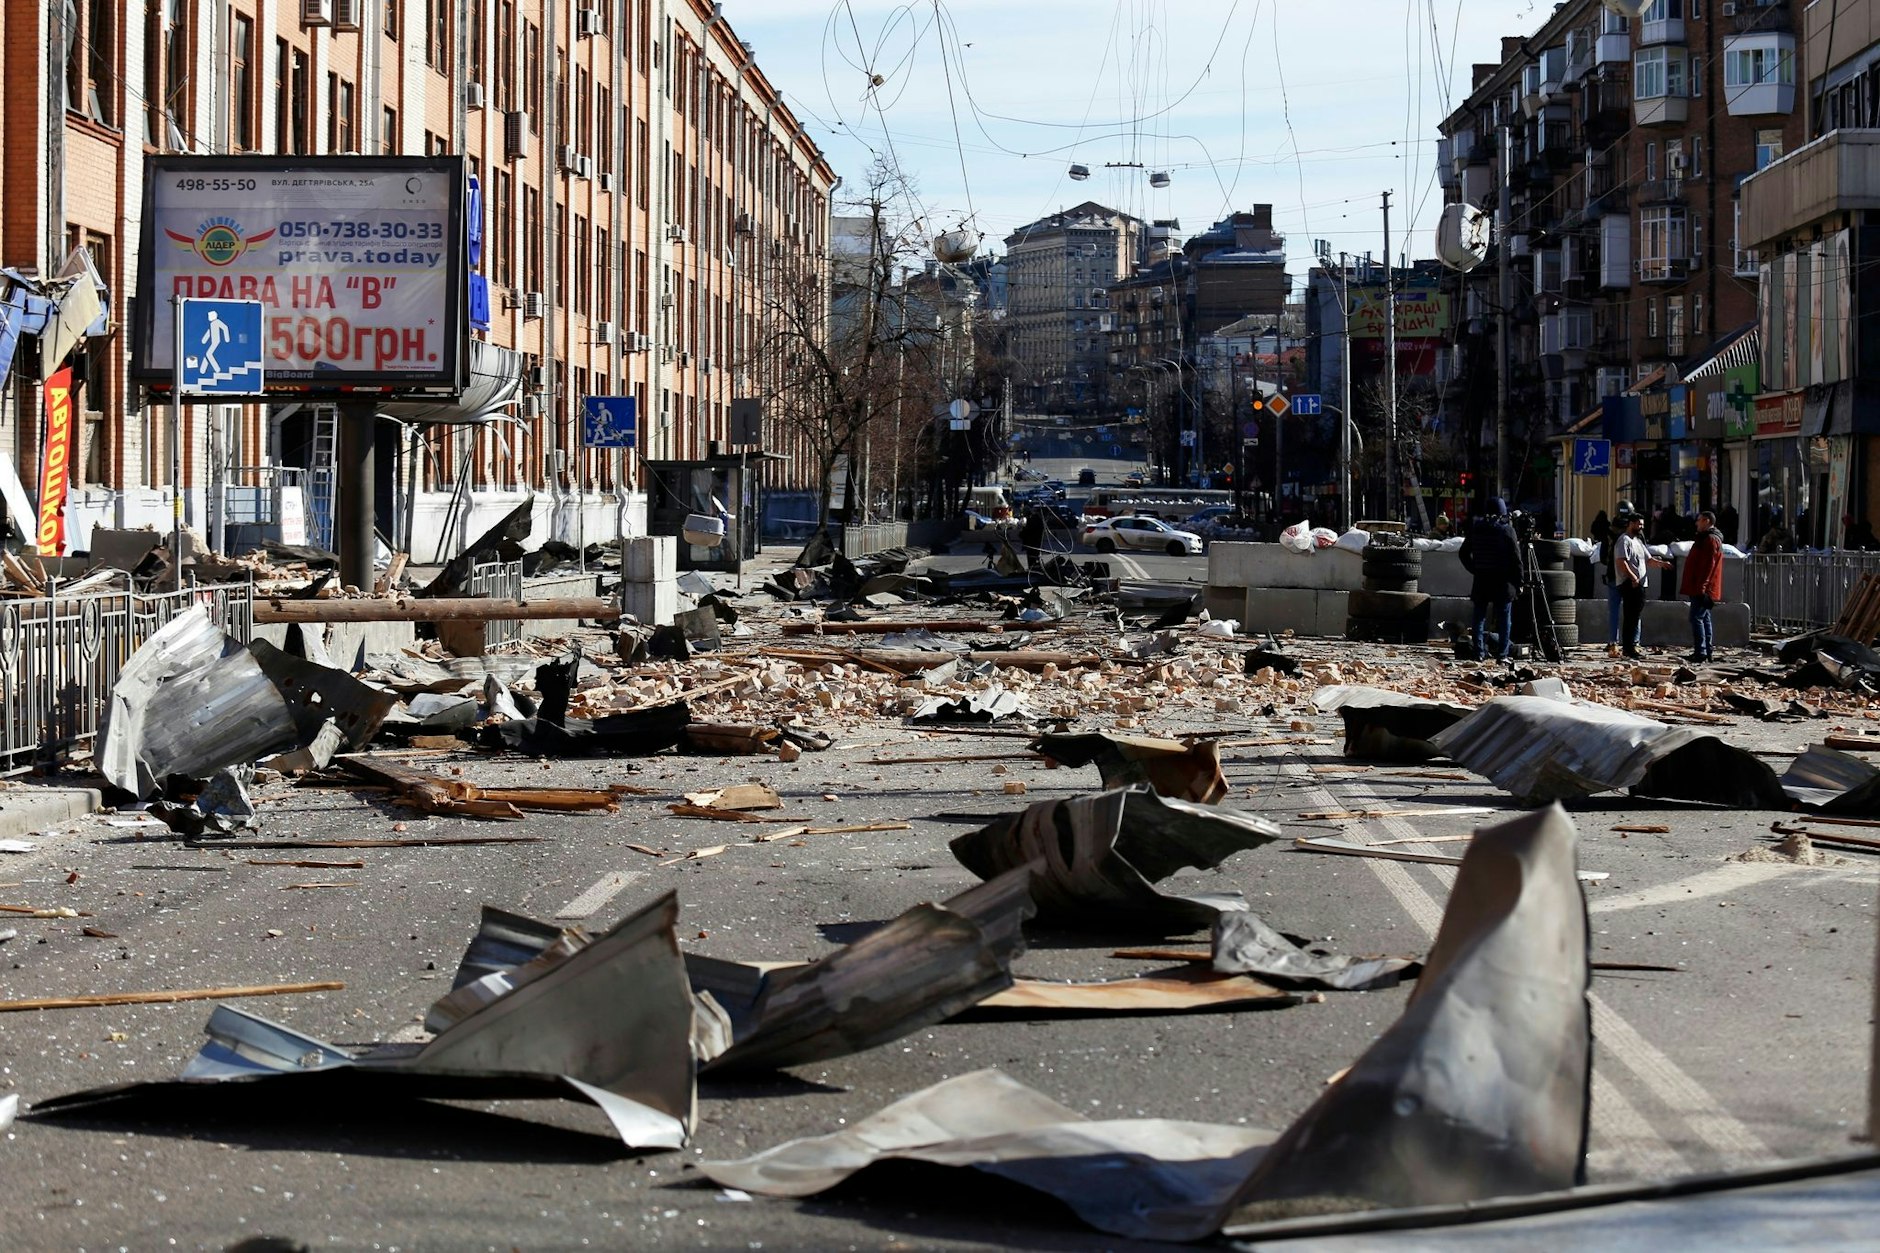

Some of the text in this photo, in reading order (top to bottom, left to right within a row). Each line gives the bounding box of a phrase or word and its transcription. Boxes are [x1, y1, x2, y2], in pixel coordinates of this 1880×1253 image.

[176, 179, 256, 191] 498-55-50
[205, 241, 236, 251] ЛІДЕР
[278, 249, 441, 268] prava.today
[173, 276, 280, 309] ПРАВА
[292, 276, 336, 309] НА
[266, 370, 314, 379] BigBoard
